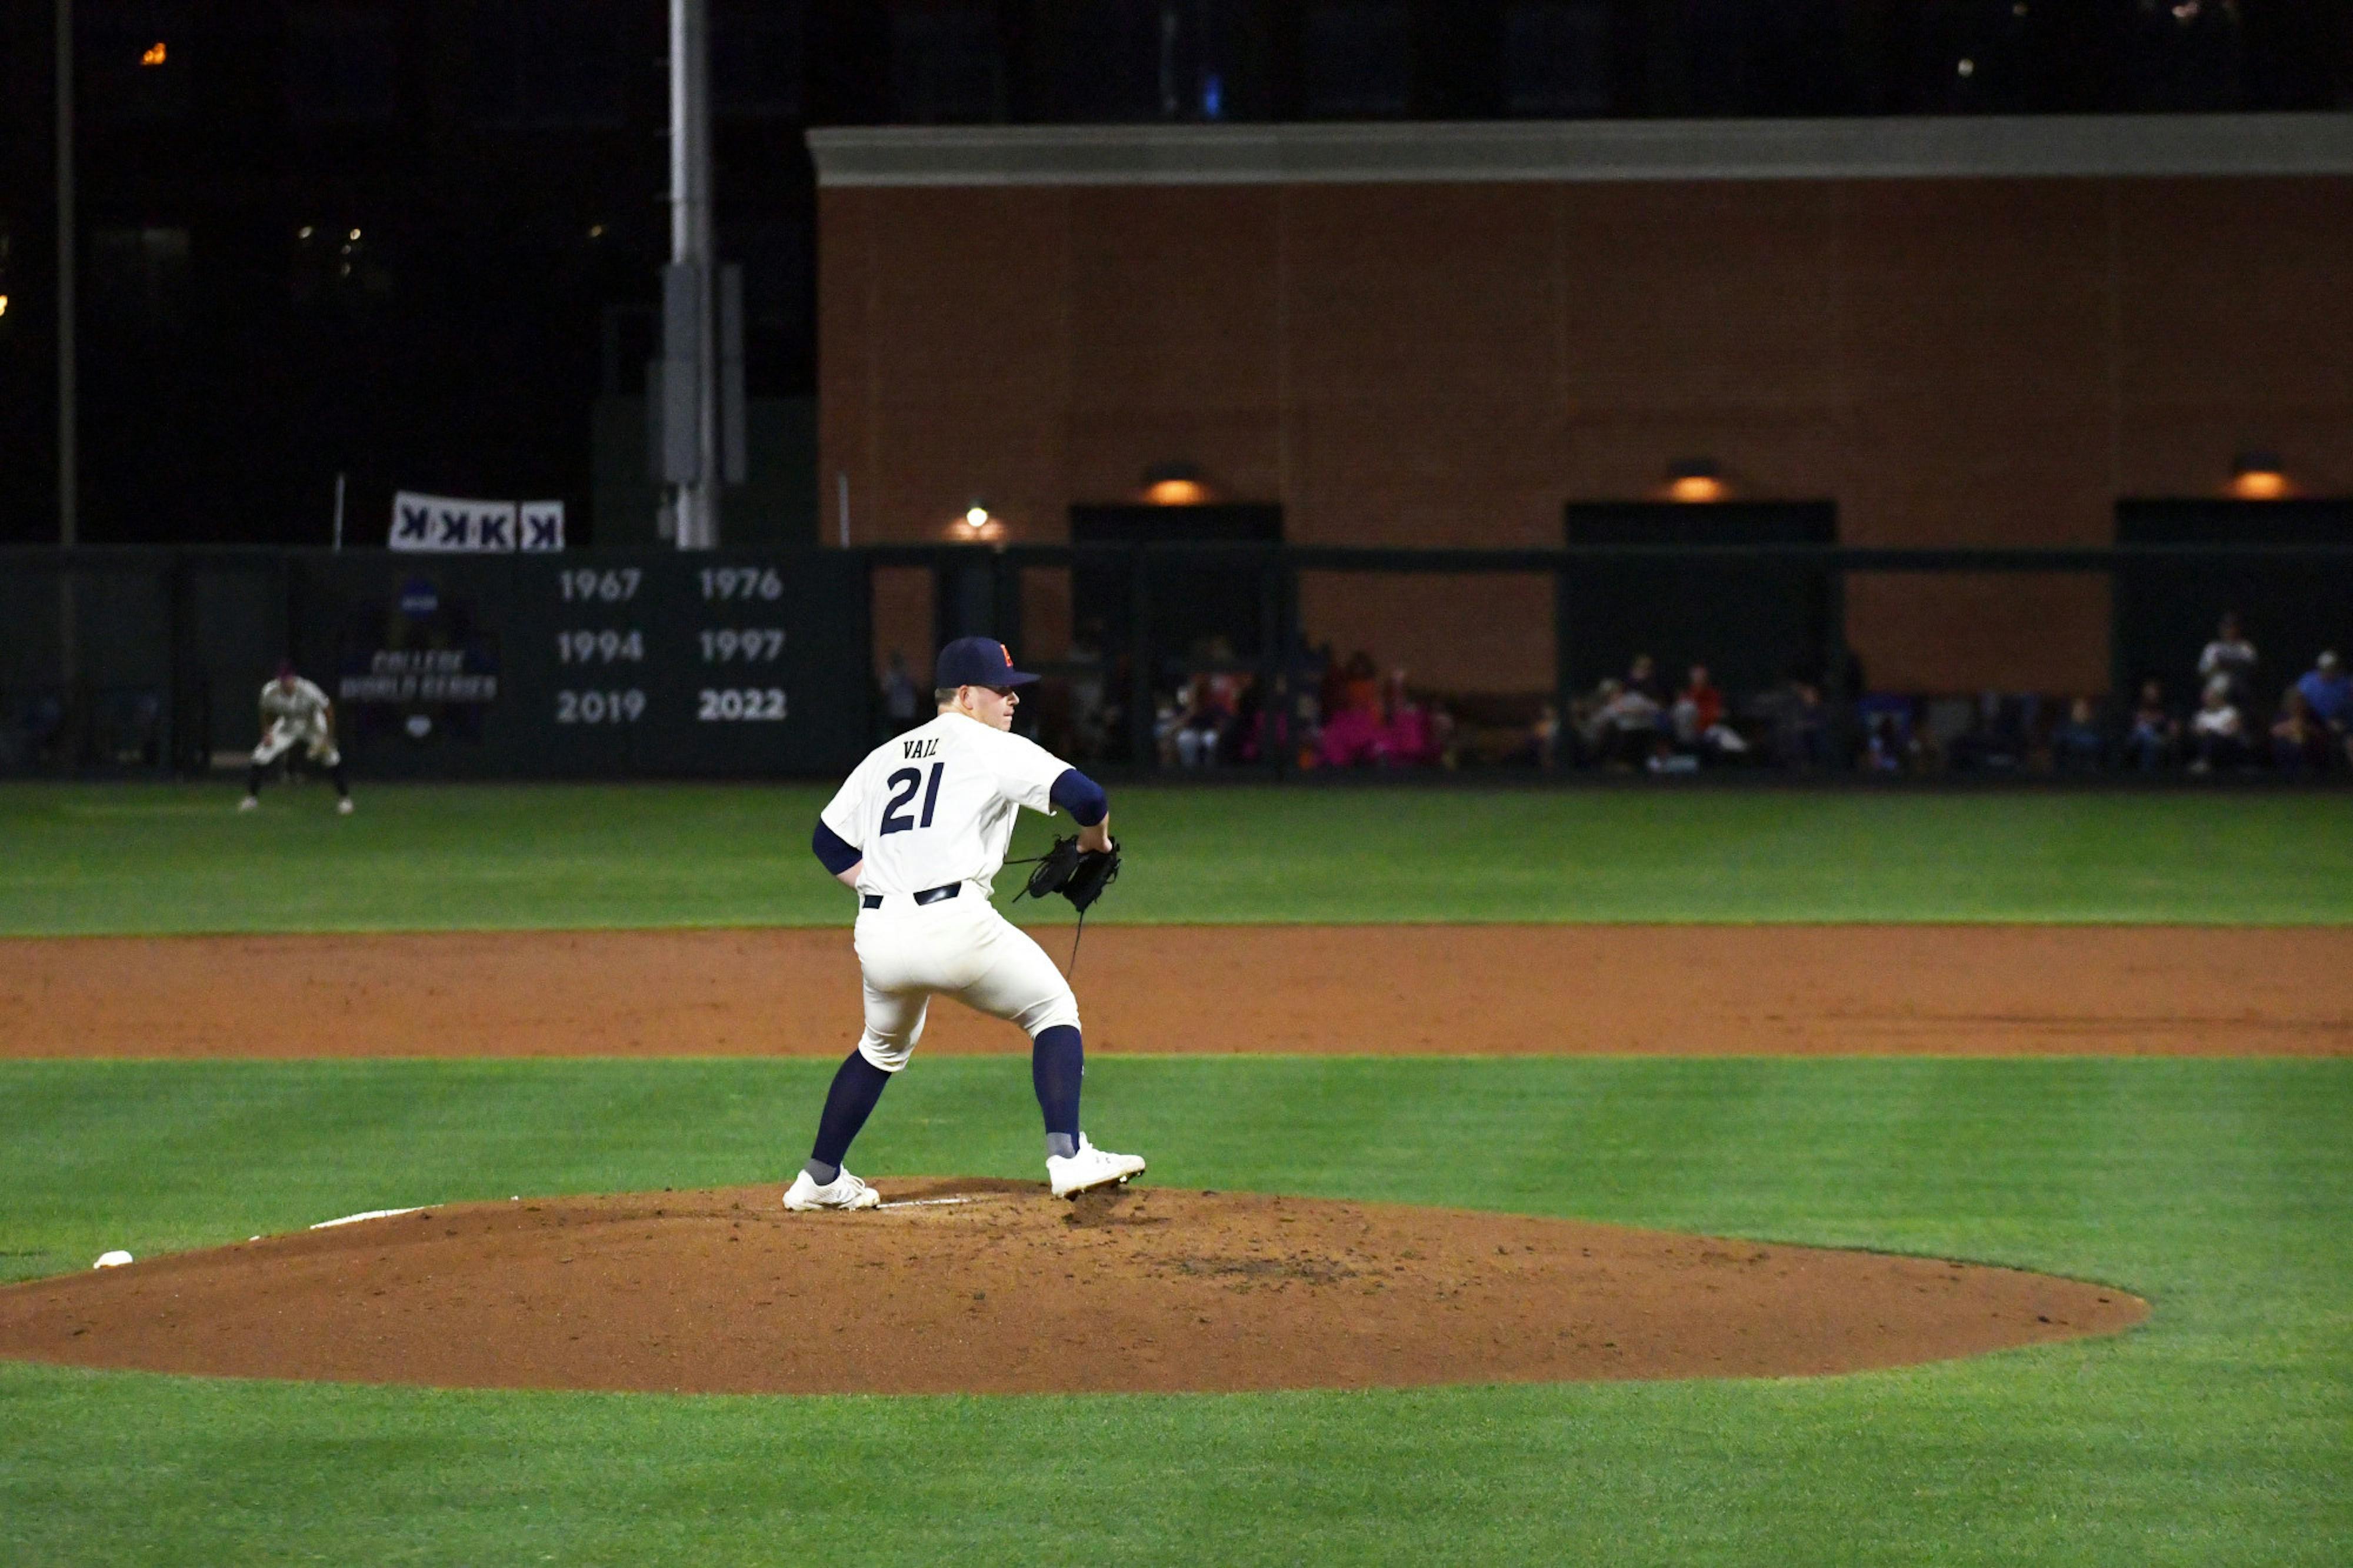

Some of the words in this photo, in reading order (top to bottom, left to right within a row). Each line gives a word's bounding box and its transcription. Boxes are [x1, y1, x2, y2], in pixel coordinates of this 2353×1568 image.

[561, 568, 642, 601] 1967
[700, 568, 782, 600] 1976
[558, 630, 644, 663] 1994
[700, 629, 785, 662] 1997
[556, 689, 646, 723] 2019
[698, 688, 787, 721] 2022
[904, 738, 939, 759] VAIL
[880, 762, 945, 837] 21
